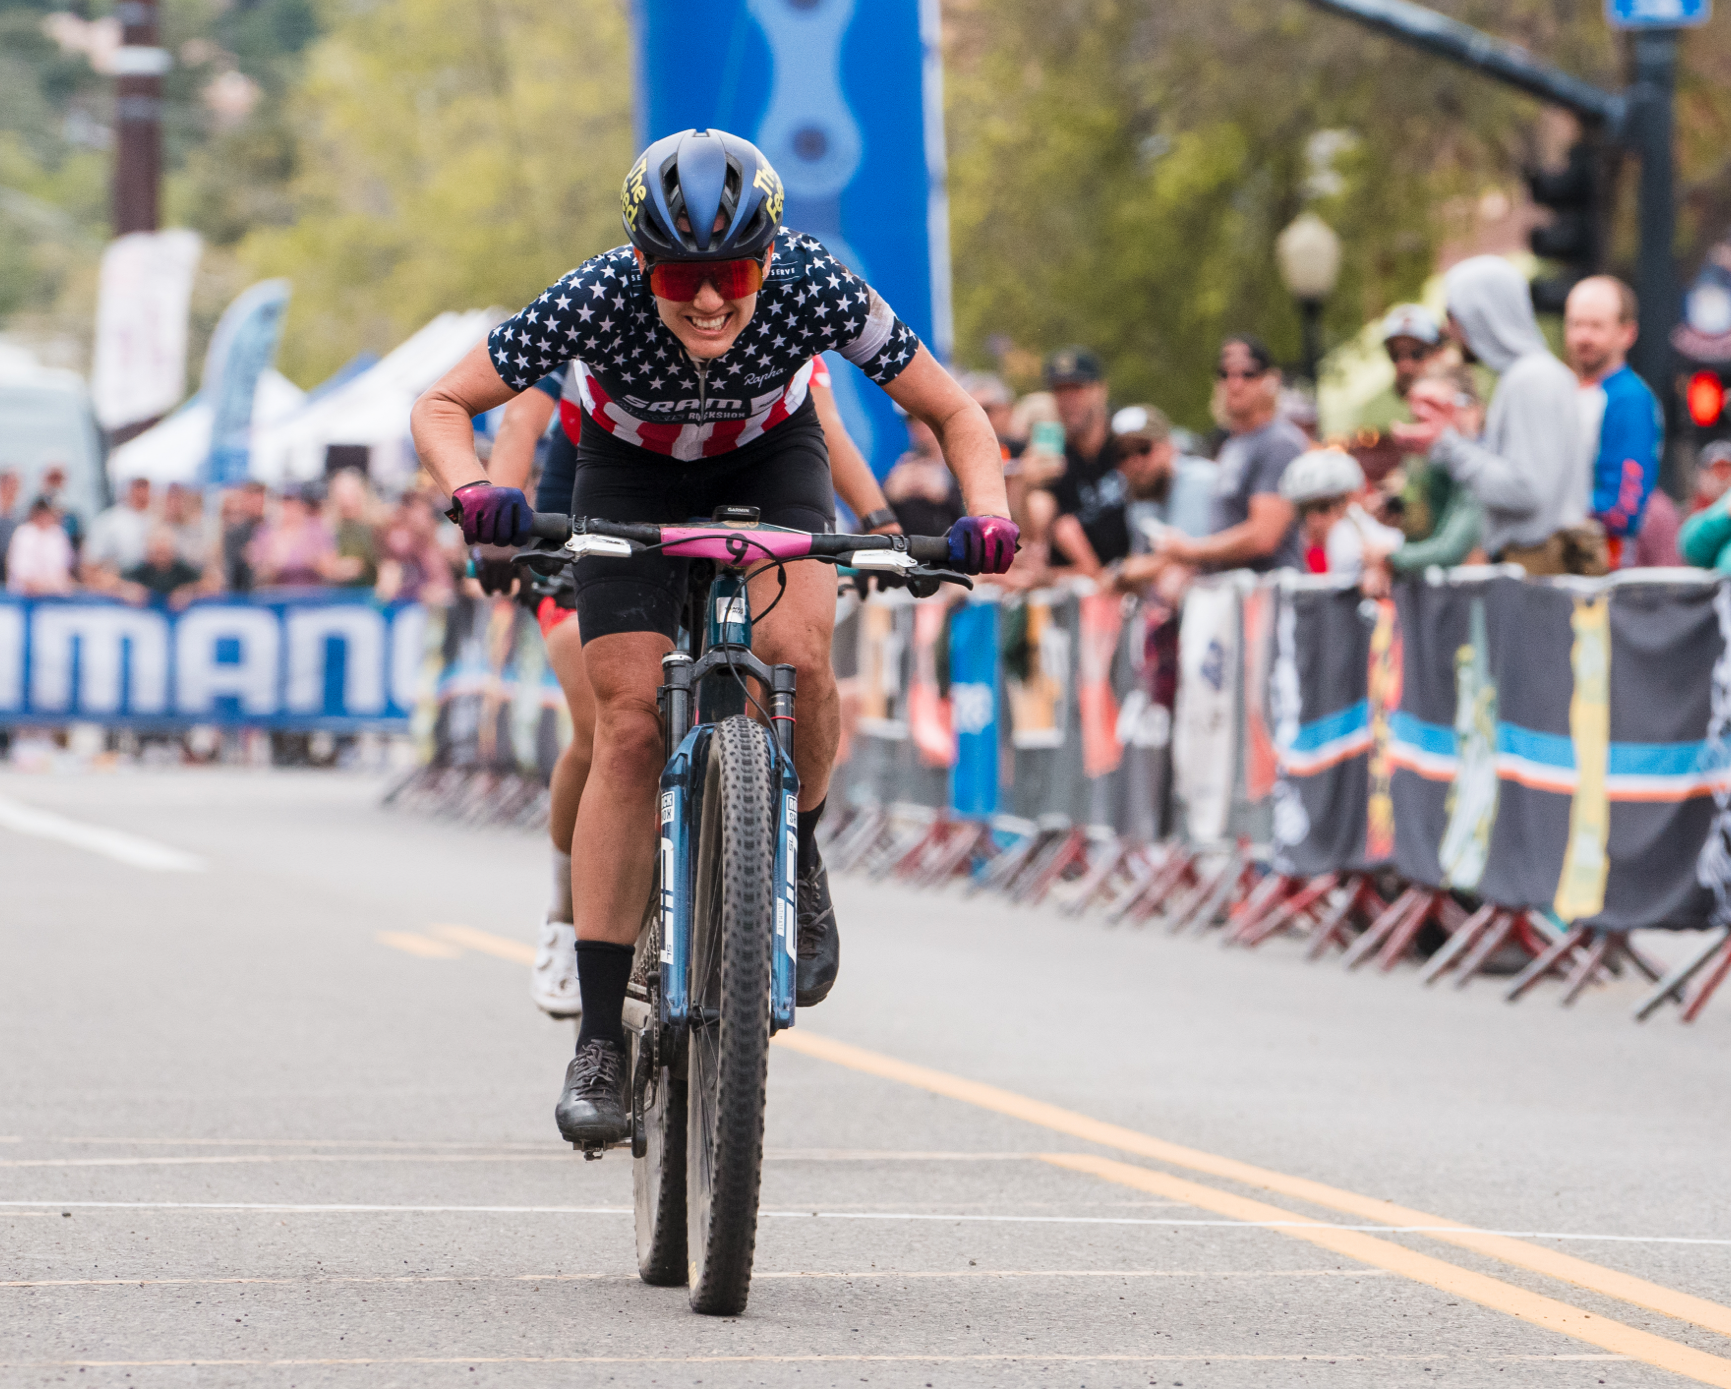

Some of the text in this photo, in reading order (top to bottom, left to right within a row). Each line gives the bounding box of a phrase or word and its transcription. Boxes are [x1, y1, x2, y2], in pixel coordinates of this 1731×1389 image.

[629, 157, 647, 204] The
[753, 160, 775, 198] The
[766, 182, 785, 225] Fee
[769, 267, 796, 276] SERVE
[622, 394, 742, 412] SRAM
[725, 533, 749, 566] 9
